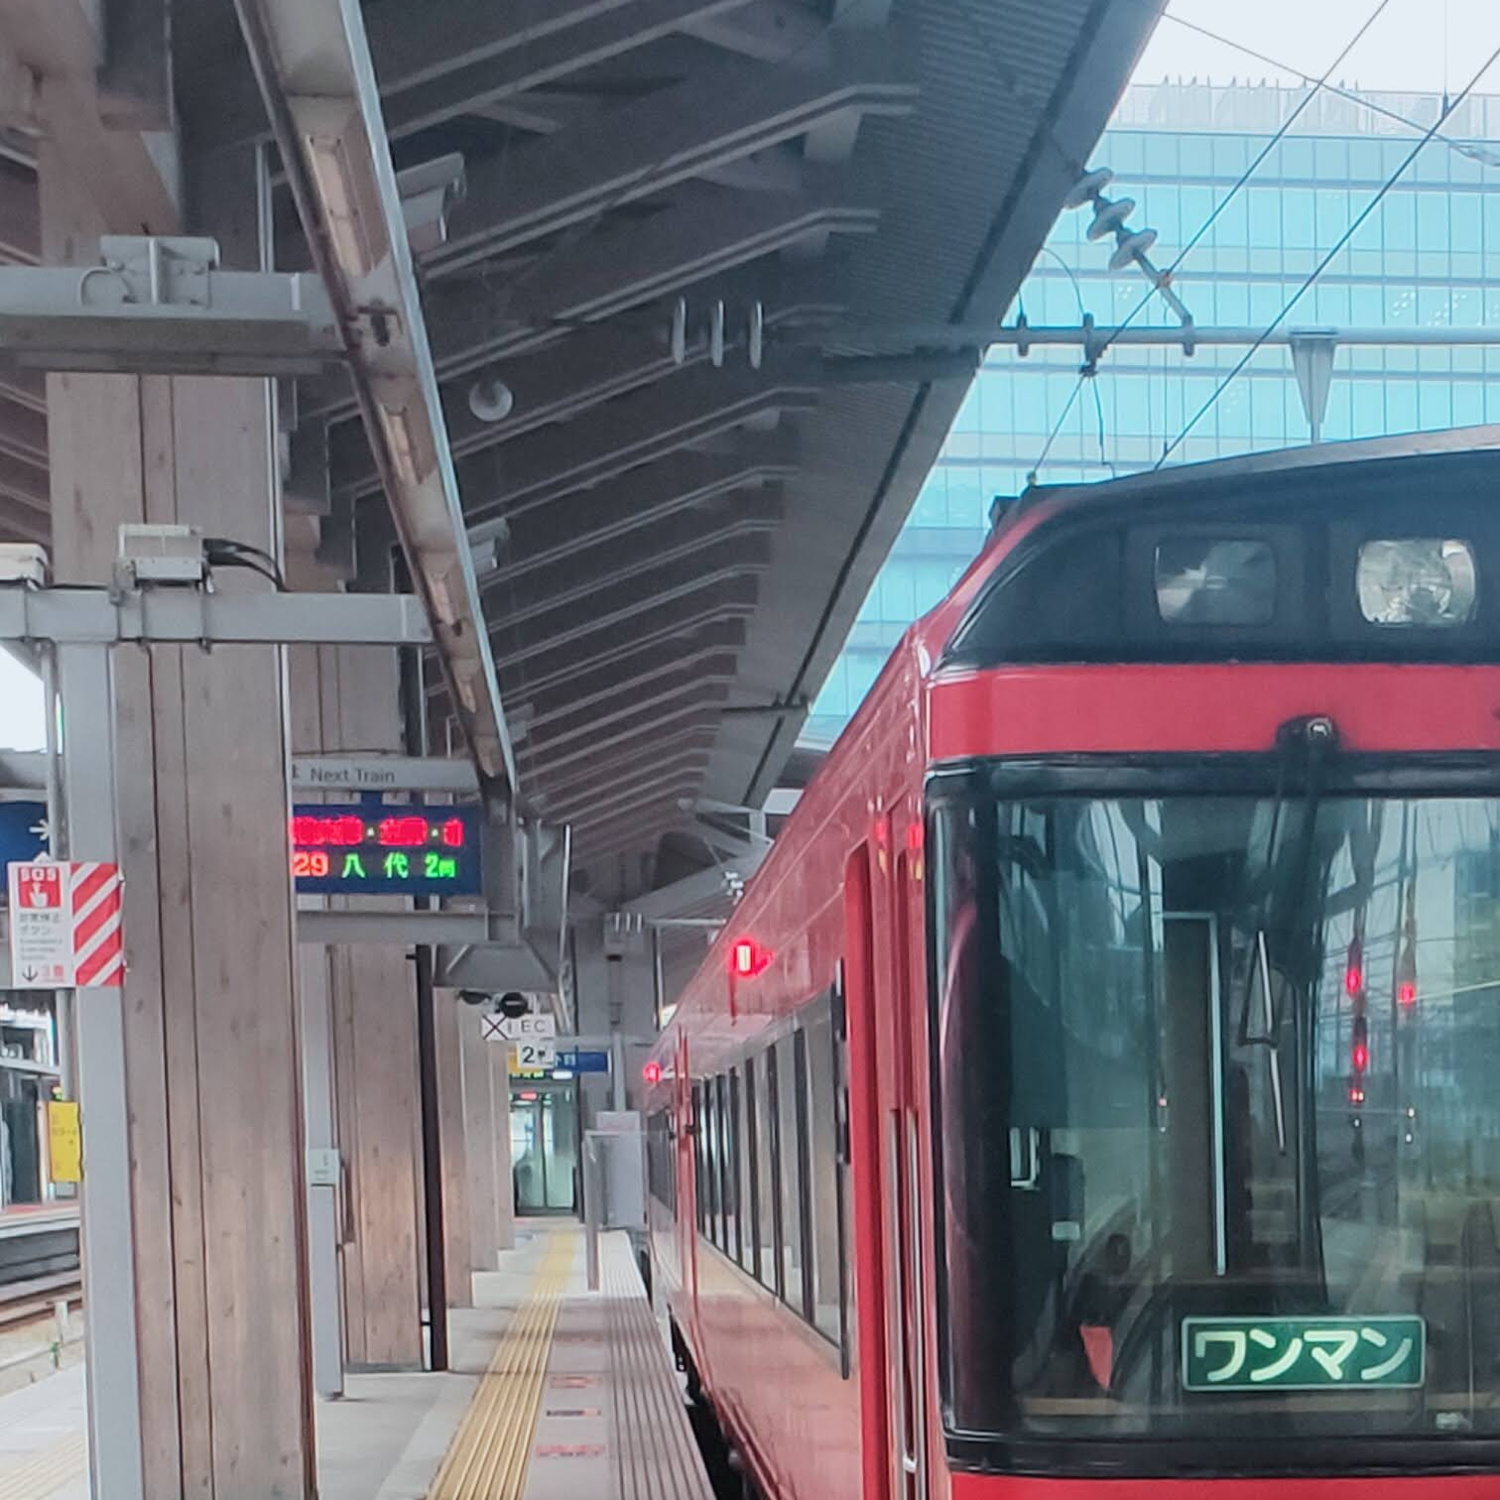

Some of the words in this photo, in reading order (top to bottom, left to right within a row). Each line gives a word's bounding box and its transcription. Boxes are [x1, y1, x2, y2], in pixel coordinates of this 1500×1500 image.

[310, 767, 349, 783] Next
[356, 768, 396, 784] Train
[341, 851, 409, 879] 八代
[1195, 1327, 1413, 1382] ワンマン
